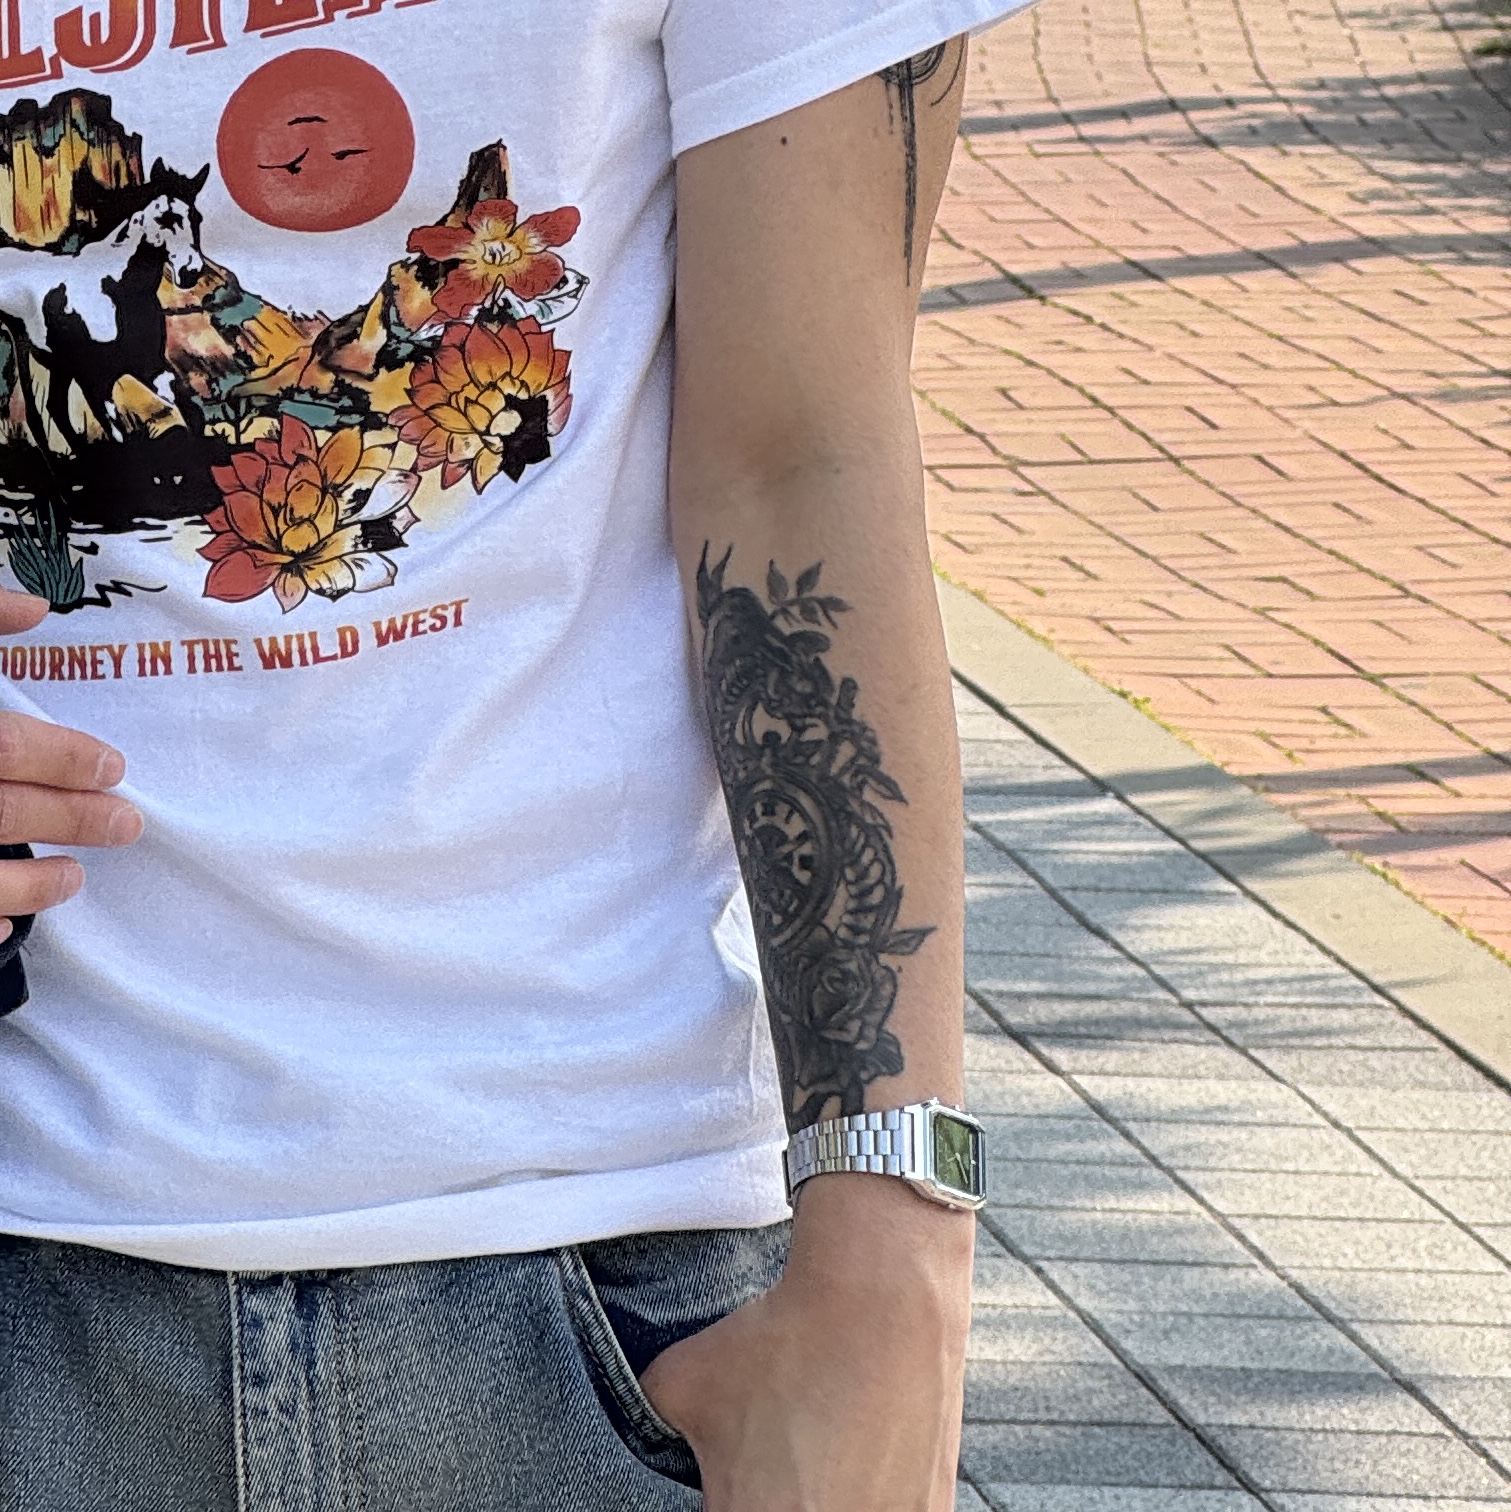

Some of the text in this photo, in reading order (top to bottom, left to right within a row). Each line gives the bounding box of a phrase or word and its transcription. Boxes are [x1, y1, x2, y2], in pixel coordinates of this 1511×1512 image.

[136, 640, 173, 677] IN
[180, 638, 244, 675] THE
[253, 625, 361, 670] WILD
[372, 598, 470, 648] WEST
